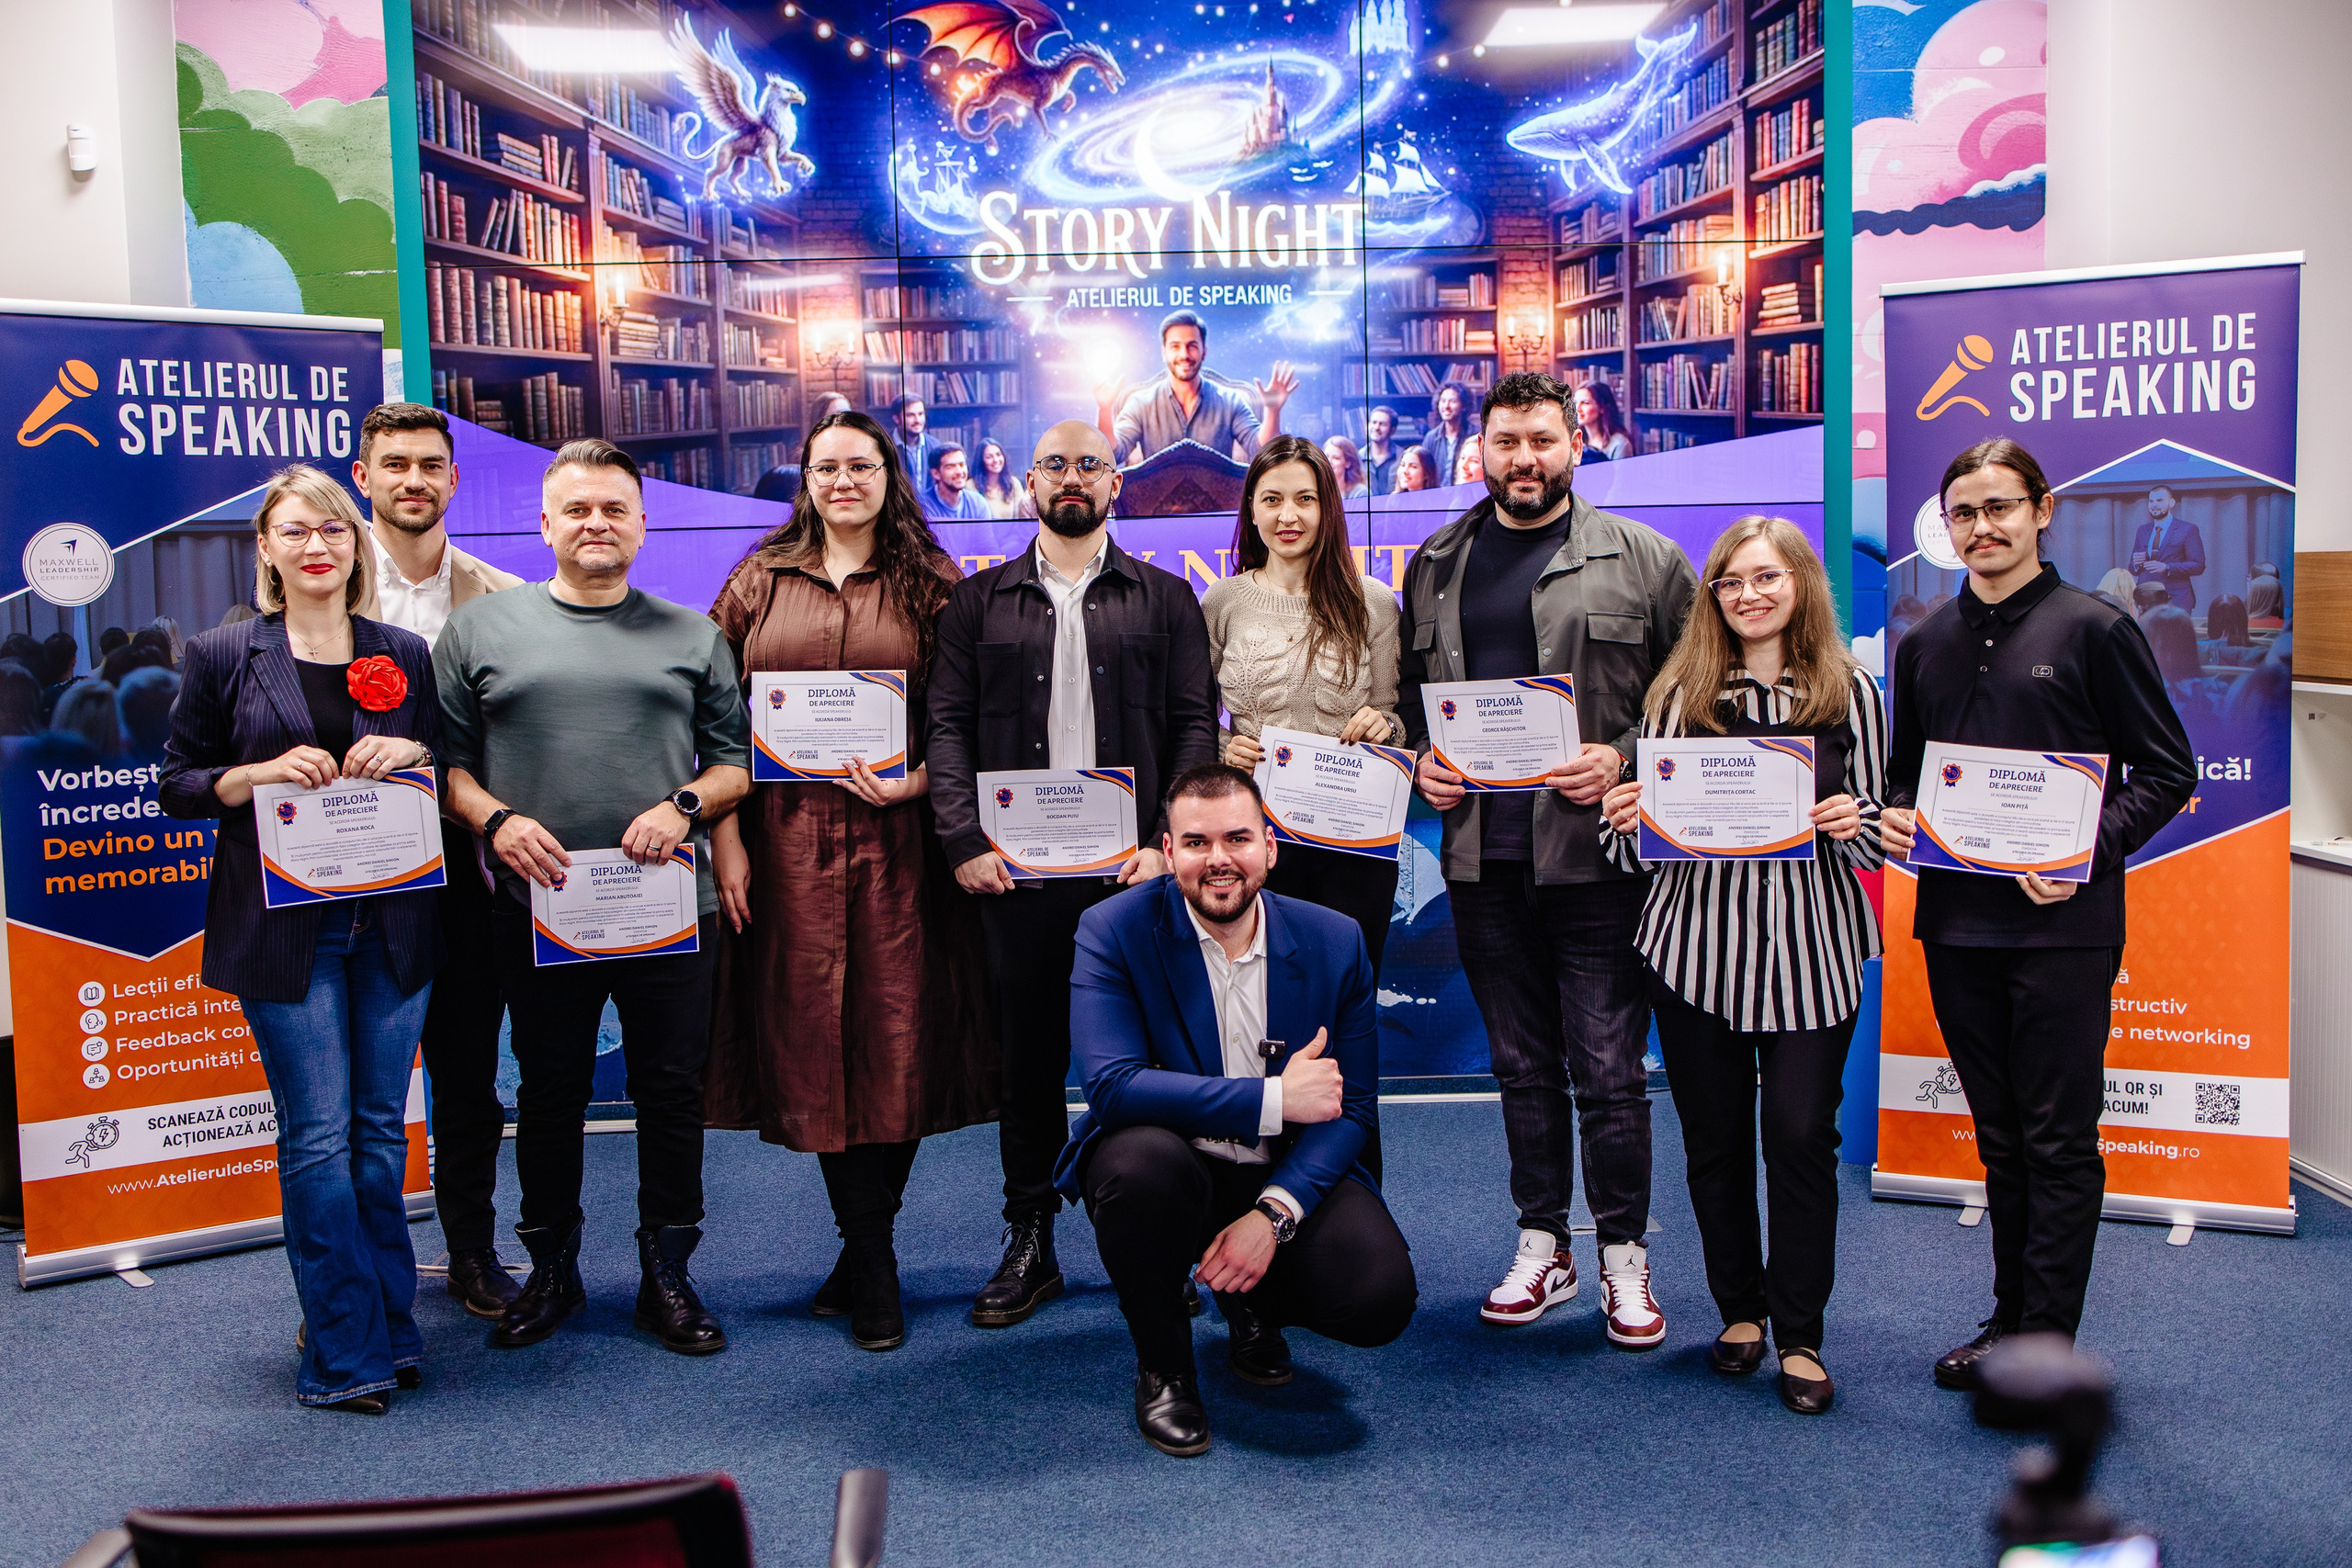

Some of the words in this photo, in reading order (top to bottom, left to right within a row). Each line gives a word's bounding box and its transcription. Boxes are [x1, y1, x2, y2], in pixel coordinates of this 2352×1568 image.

[971, 190, 1174, 286] STORY
[1193, 190, 1368, 271] NIGHT
[1066, 287, 1164, 308] ATELIERUL
[1170, 287, 1195, 306] DE
[1199, 284, 1293, 306] SPEAKING
[2010, 316, 2198, 366] ATELIERUL
[2212, 312, 2256, 352] DE
[117, 358, 299, 400] ATELIERUL
[311, 367, 349, 402] DE
[2009, 357, 2256, 423] SPEAKING
[118, 402, 352, 458] SPEAKING
[808, 687, 856, 698] DIPLOMĂ
[1476, 694, 1523, 708] DIPLOMĂ
[1315, 752, 1363, 769] DIPLOMĂ
[1701, 755, 1757, 768] DIPLOMĂ
[37, 763, 161, 792] Vorbeșt
[1324, 766, 1361, 778] APRECIERE
[1989, 768, 2046, 783] DIPLOMĂ
[1035, 784, 1084, 796] DIPLOMĂ
[1315, 782, 1343, 791] ALEXANDRA
[2000, 784, 2042, 793] APRECIERE
[322, 791, 379, 807] DIPLOMĂ
[39, 796, 164, 826] încrede
[337, 806, 379, 817] APRECIERE
[1292, 816, 1315, 824] SPEAKING
[43, 831, 155, 860] Devino
[164, 829, 204, 849] un
[1963, 840, 1990, 849] SPEAKING
[604, 876, 641, 885] APRECIERE
[112, 977, 168, 998] Lecții
[115, 1001, 198, 1026] Practică
[204, 998, 242, 1014] inte
[2110, 998, 2188, 1014] structiv
[116, 1027, 216, 1053] Feedback
[2130, 1027, 2250, 1050] networking
[117, 1049, 243, 1081] Oportunități
[2125, 1081, 2144, 1094] QR
[2149, 1083, 2163, 1099] ȘI
[148, 1106, 225, 1130] SCANEAZĂ
[230, 1101, 275, 1119] CODUL
[163, 1121, 254, 1147] ACȚIONEAZĂ
[2097, 1138, 2200, 1159] Speaking.ro
